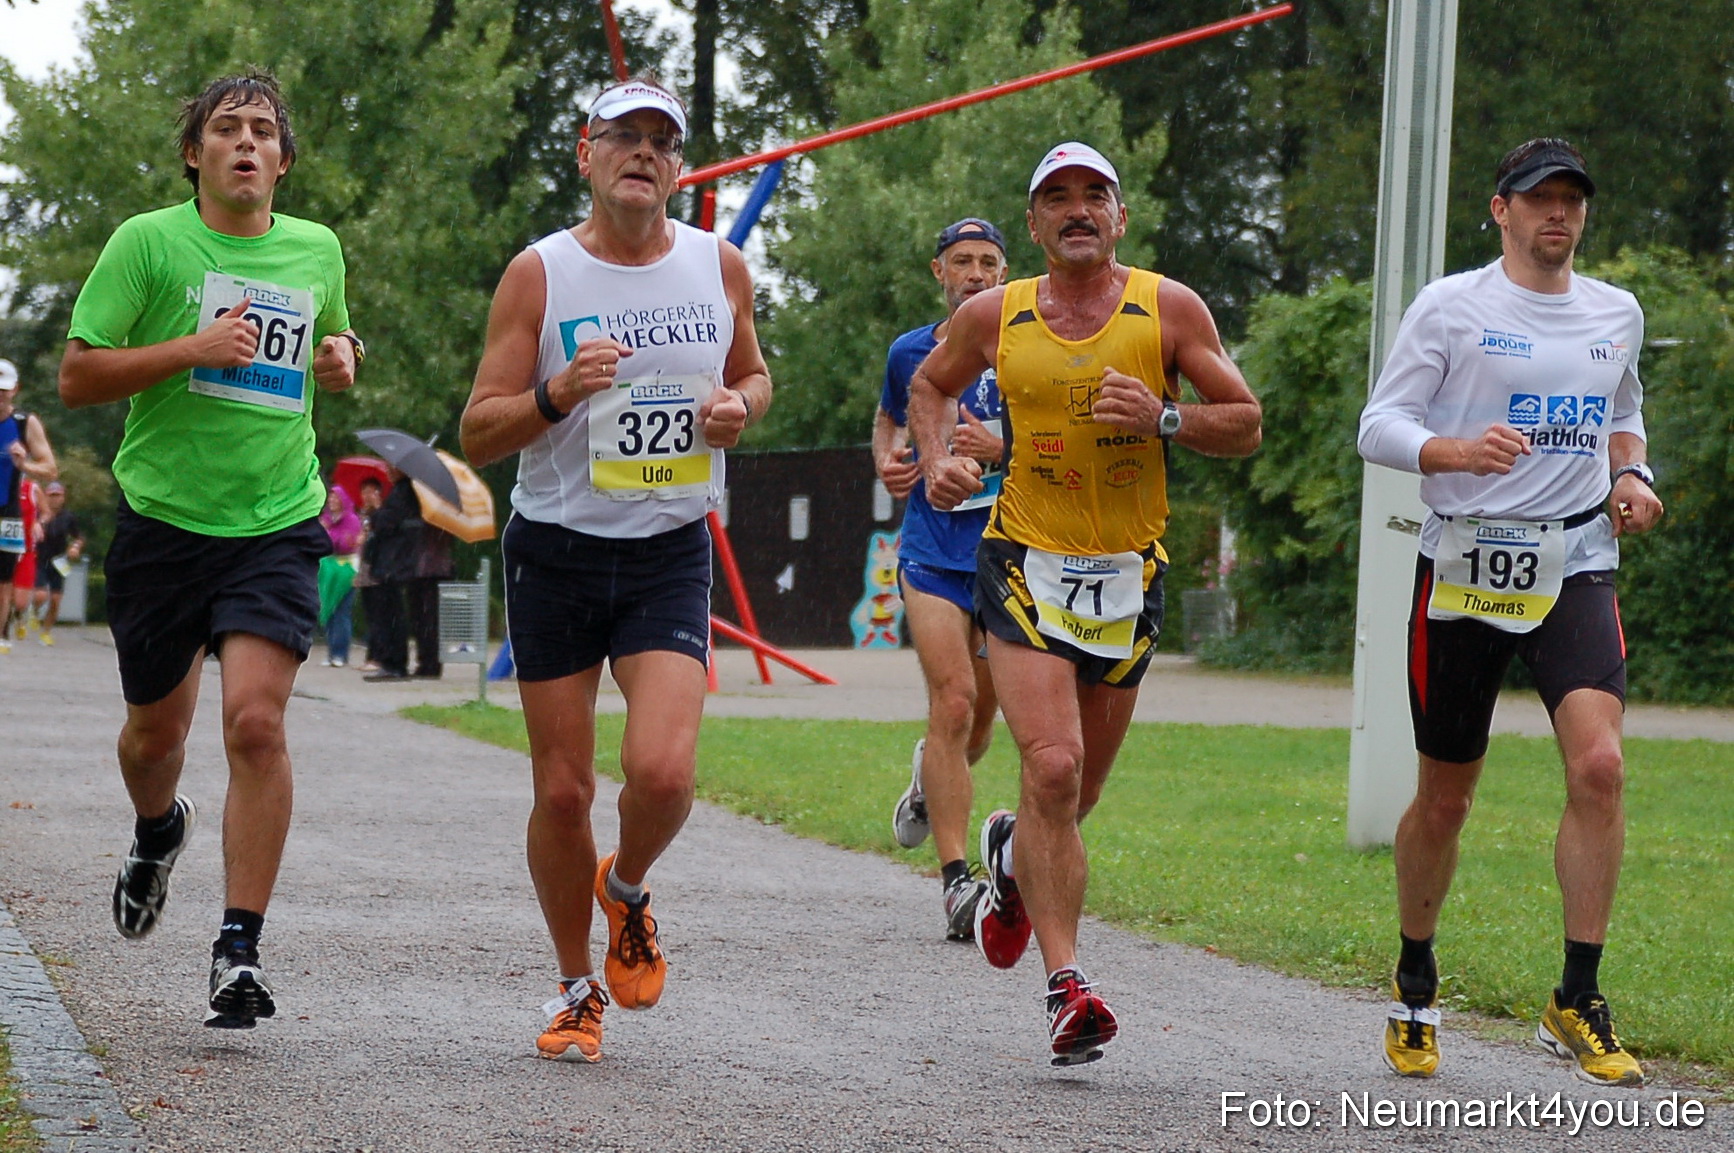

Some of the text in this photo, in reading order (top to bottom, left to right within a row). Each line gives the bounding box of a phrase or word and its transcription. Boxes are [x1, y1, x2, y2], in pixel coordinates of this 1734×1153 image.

[243, 288, 291, 306] BOCK
[606, 302, 716, 329] HÖRGERÄTE
[609, 322, 719, 349] MECKLER
[221, 366, 286, 391] Michael
[631, 384, 683, 398] BOCK
[617, 408, 695, 457] 323
[1032, 439, 1064, 453] Seidl
[642, 465, 673, 484] Udo
[1476, 526, 1527, 540] BOCK
[1462, 547, 1539, 592] 193
[1060, 577, 1104, 616] 71
[1463, 592, 1526, 616] Thomas
